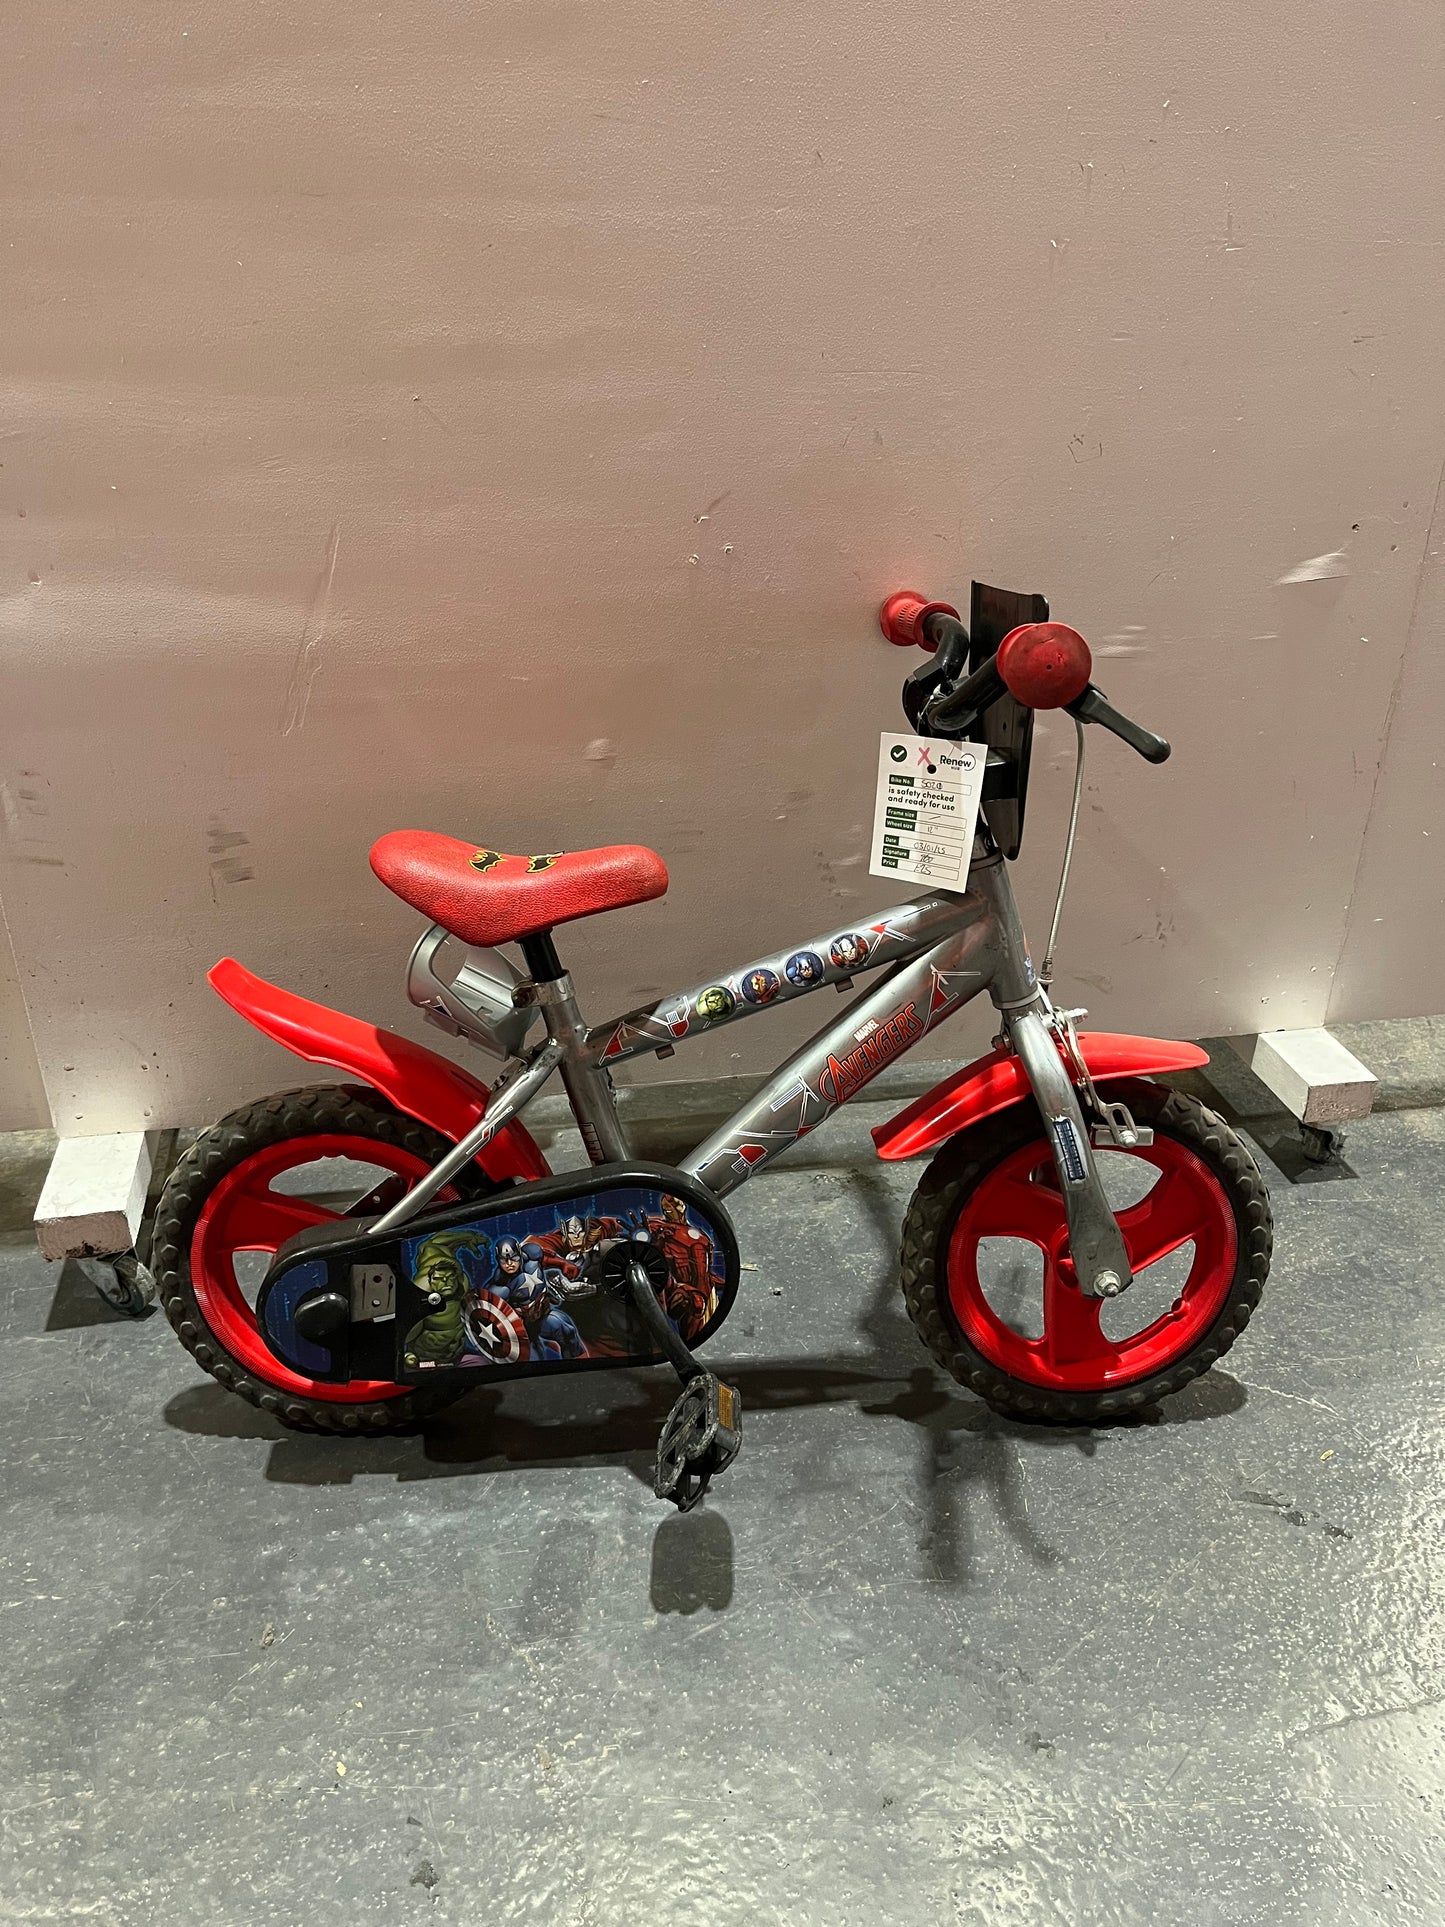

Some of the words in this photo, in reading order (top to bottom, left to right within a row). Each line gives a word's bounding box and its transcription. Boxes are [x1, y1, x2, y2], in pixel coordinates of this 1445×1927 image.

[940, 755, 972, 768] Renew
[888, 786, 895, 794] is
[897, 786, 921, 798] safety
[922, 791, 955, 803] checked
[888, 795, 903, 804] and
[904, 798, 928, 809] ready
[929, 800, 940, 809] for
[887, 808, 904, 817] Frame
[904, 810, 915, 818] size
[886, 820, 902, 828] Wheel
[902, 821, 913, 829] size
[883, 847, 907, 857] Signature
[853, 1018, 880, 1043] MARVEL
[819, 1002, 924, 1104] AVENGERS
